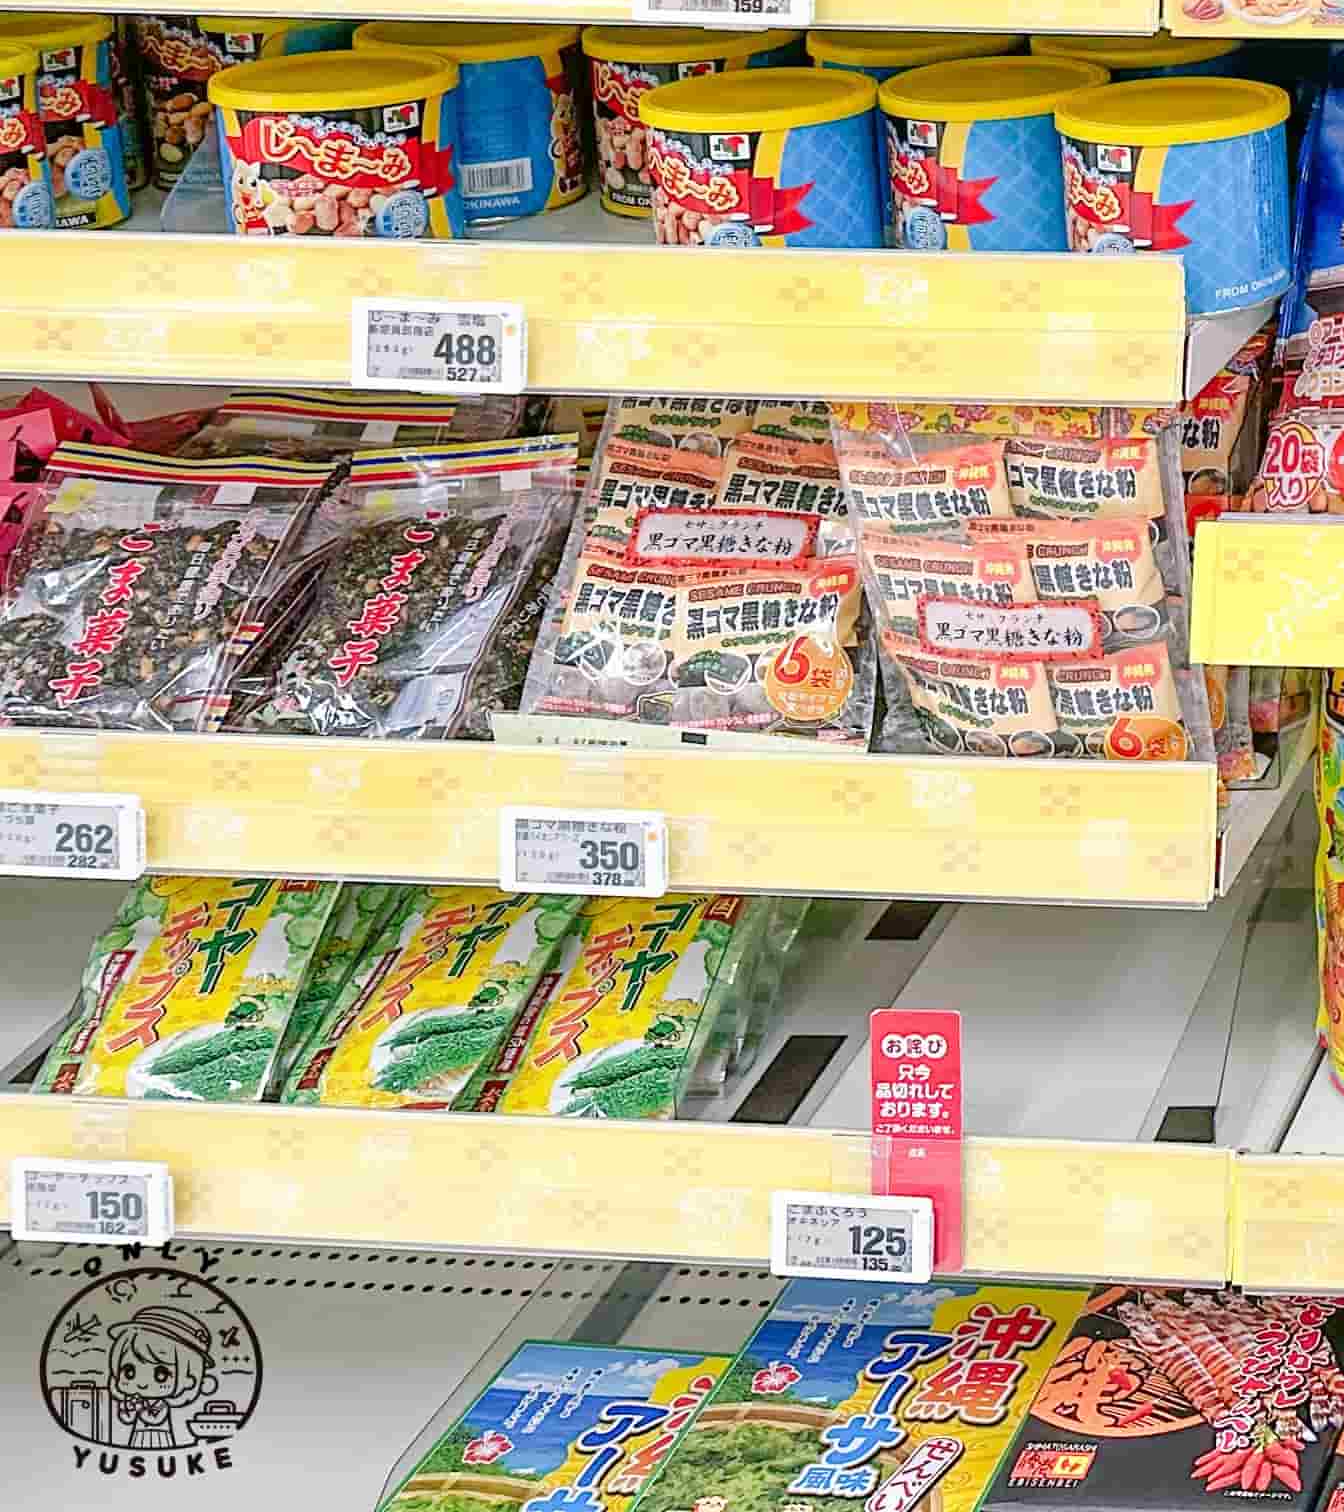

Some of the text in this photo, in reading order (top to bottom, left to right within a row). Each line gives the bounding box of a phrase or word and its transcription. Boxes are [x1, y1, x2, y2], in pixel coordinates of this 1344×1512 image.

[433, 333, 496, 366] 488
[643, 533, 795, 557] 黒ゴマ黒糖きな粉
[685, 595, 840, 640] 黒ゴマ黒糖きな粉
[934, 620, 1087, 649] 黒ゴマ黒糖きな粉
[54, 822, 114, 855] 262
[579, 839, 640, 871] 350
[199, 877, 275, 994] ゴーヤー
[620, 899, 698, 1013] ゴーヤー
[884, 1037, 945, 1055] お詫び
[898, 1064, 931, 1081] 只今
[875, 1083, 954, 1100] 品切れして
[879, 1101, 951, 1119] おります。
[84, 1190, 145, 1221] 150
[848, 1224, 908, 1256] 125
[909, 1304, 1054, 1426] 沖縄
[821, 1331, 956, 1468] アーサ
[790, 1466, 873, 1493] 風味
[869, 1439, 963, 1512] せんべい
